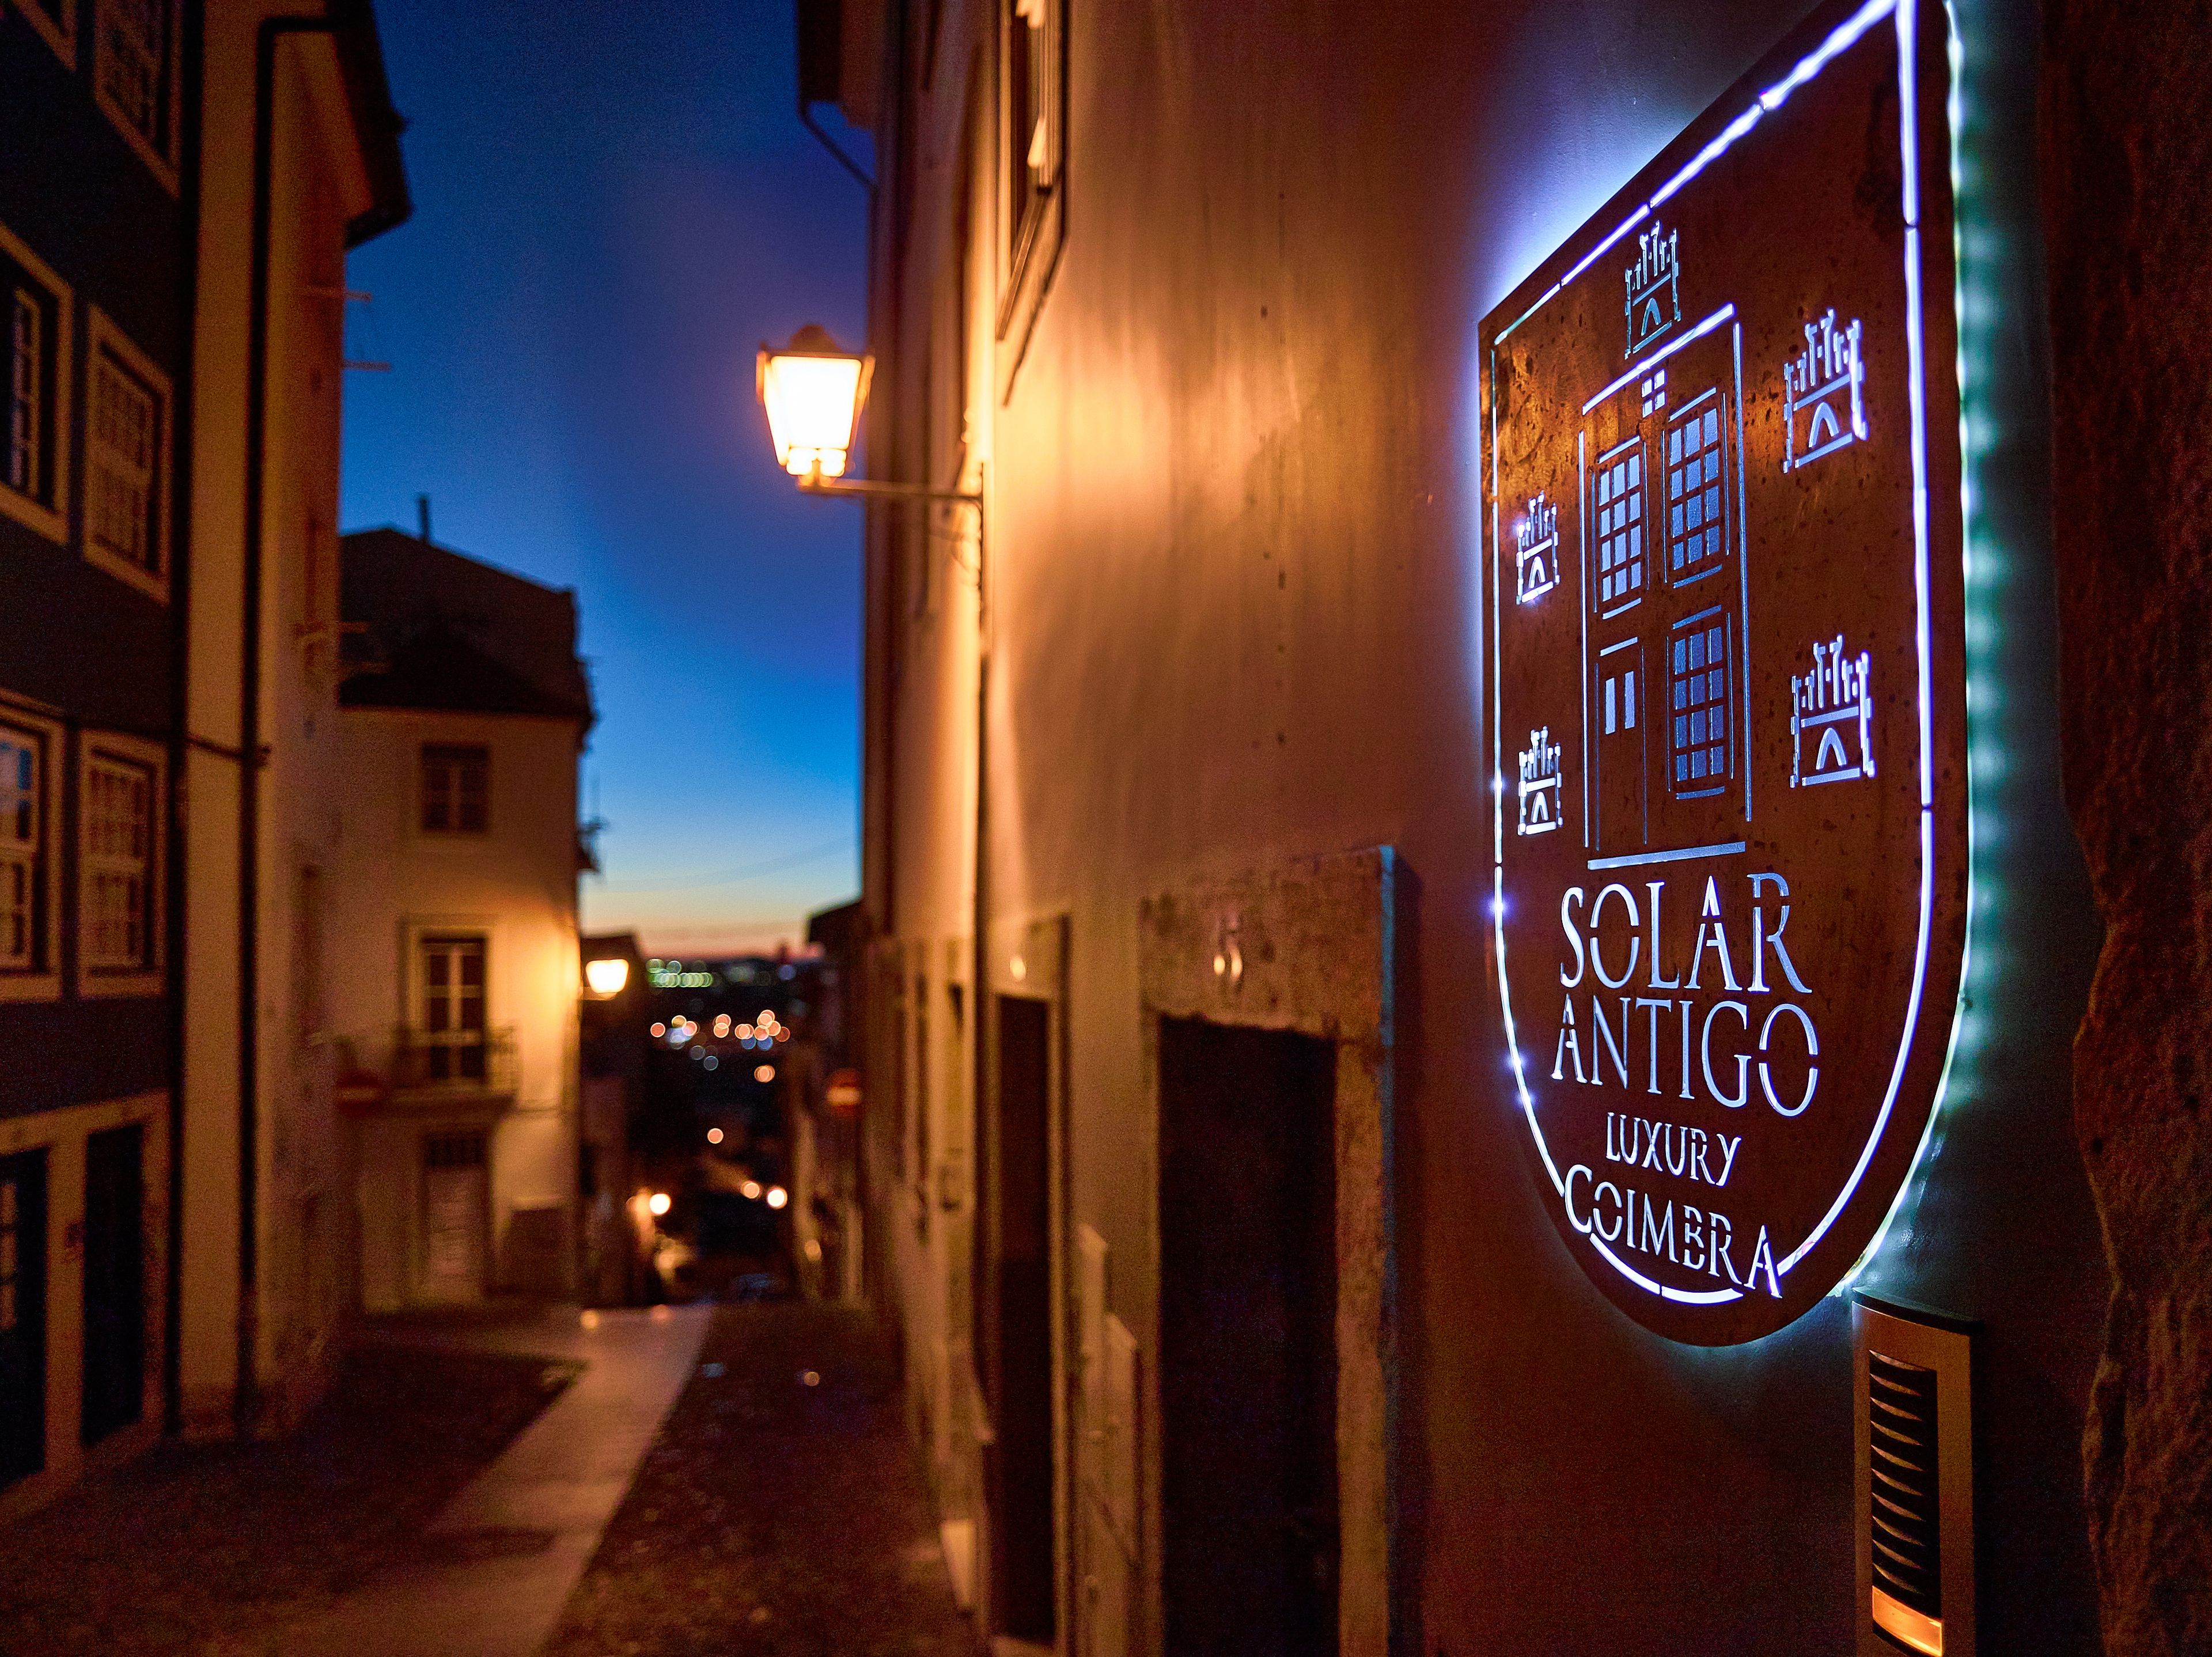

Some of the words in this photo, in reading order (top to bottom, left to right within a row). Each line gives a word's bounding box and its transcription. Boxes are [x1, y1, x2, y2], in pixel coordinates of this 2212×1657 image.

[1560, 872, 1813, 993] SOLAR
[1551, 993, 1819, 1117] ANTIGO
[1605, 1112, 1742, 1186] LUXURY
[1564, 1164, 1783, 1299] COIMBRA
